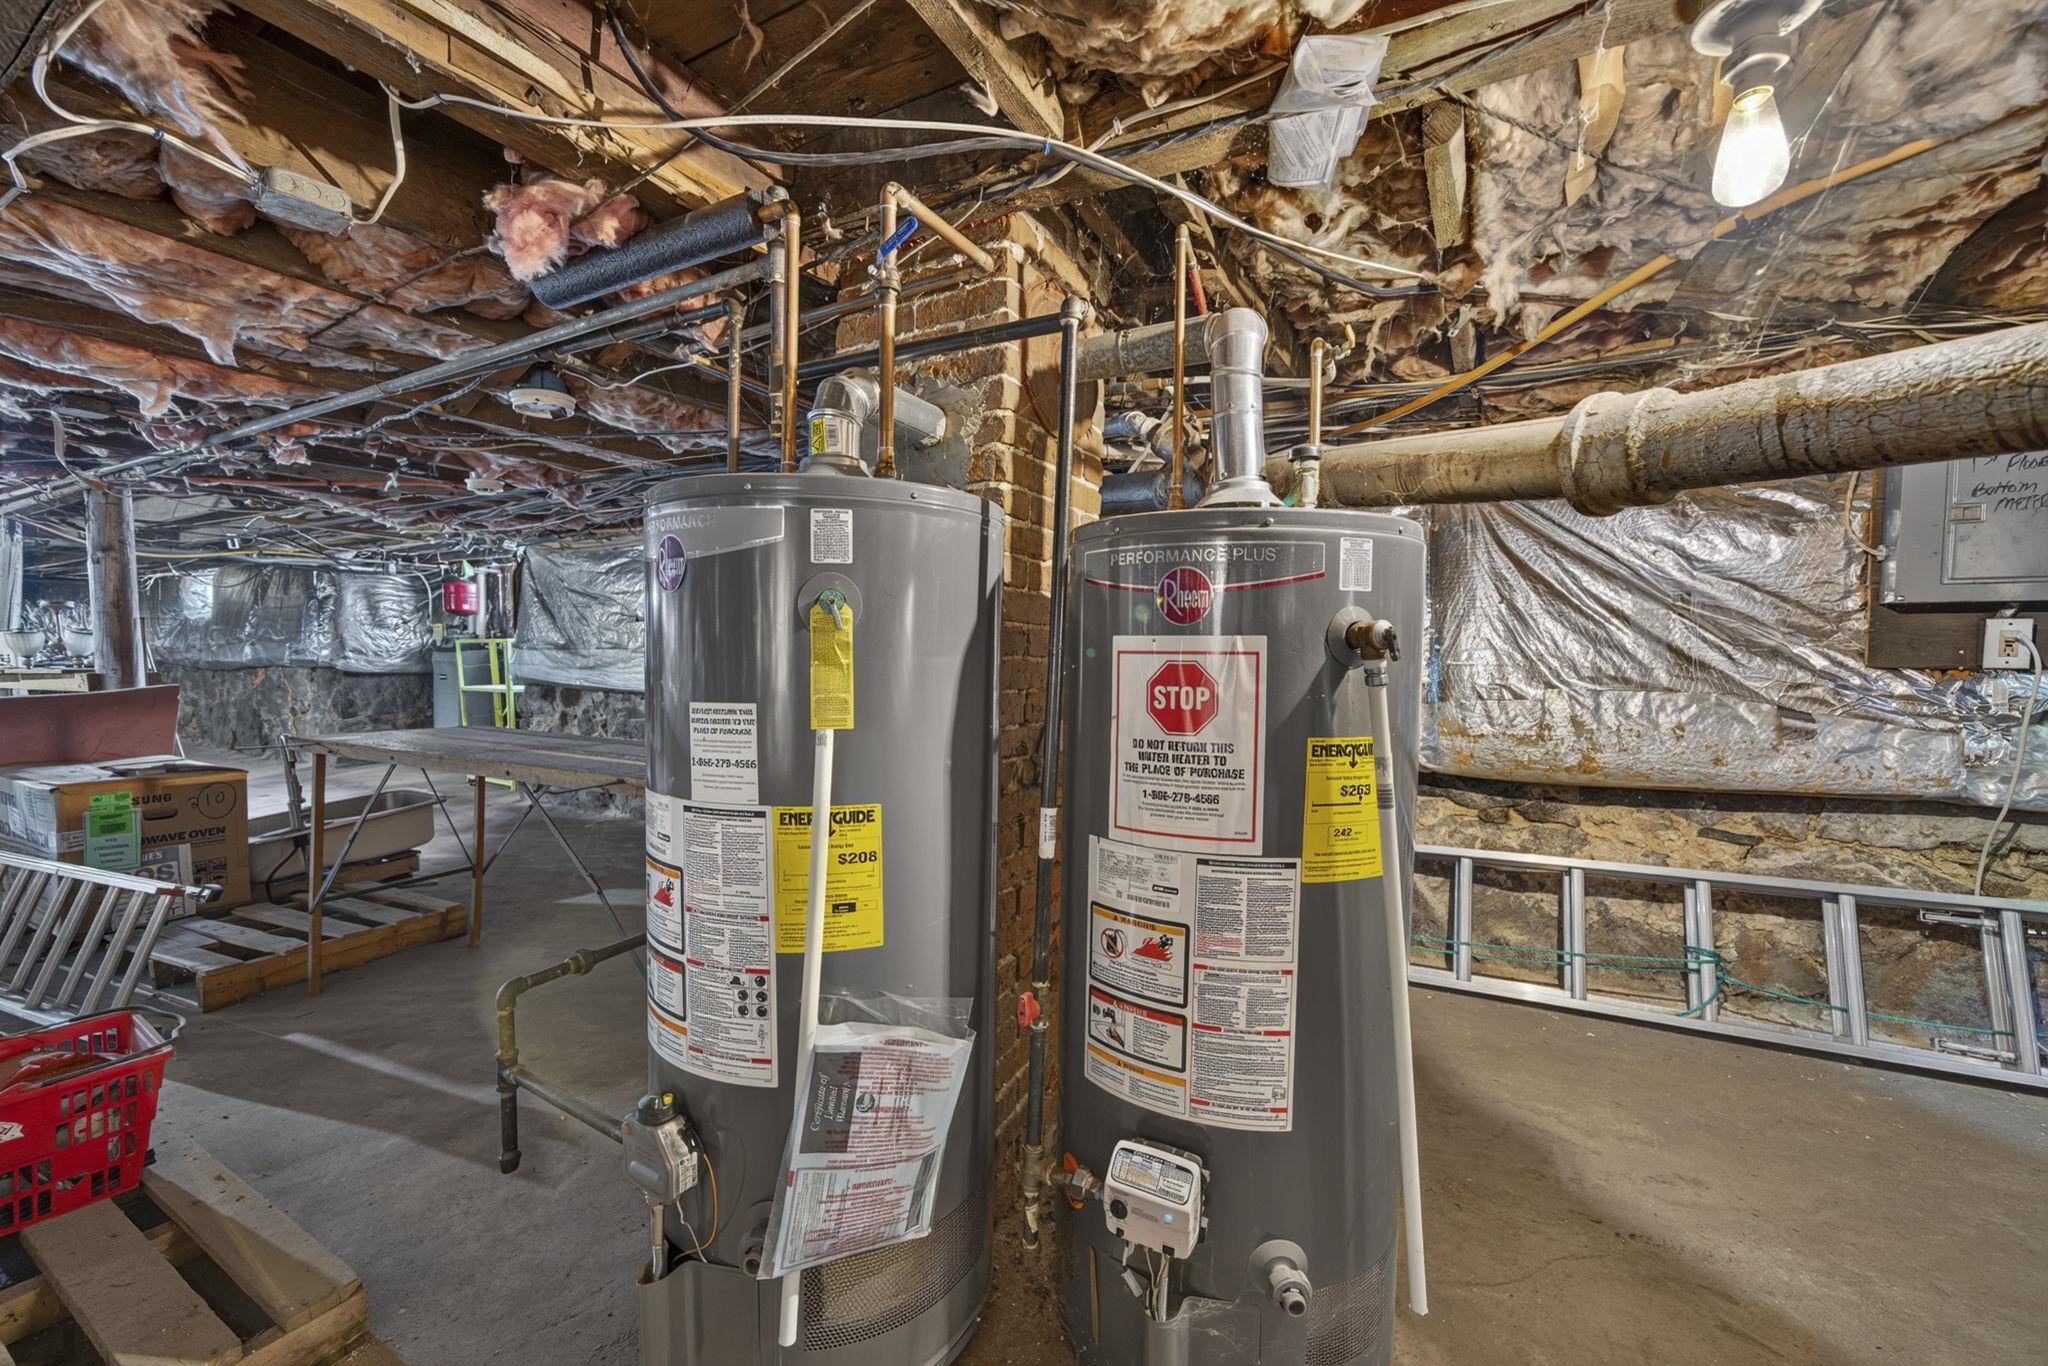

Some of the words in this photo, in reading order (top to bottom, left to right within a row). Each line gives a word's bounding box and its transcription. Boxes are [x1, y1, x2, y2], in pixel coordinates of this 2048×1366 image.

[1110, 548, 1227, 566] PERFORMANCE
[1233, 547, 1277, 562] PLUS
[1164, 569, 1209, 617] Rheem
[1153, 685, 1210, 711] STOP
[1133, 738, 1144, 749] DO
[1147, 739, 1165, 751] NOT
[1168, 741, 1207, 753] RETURN
[1211, 743, 1234, 754] THIS
[1138, 751, 1169, 763] WATER
[1172, 753, 1210, 766] HEATER
[1213, 755, 1227, 767] TO
[1124, 762, 1139, 772] THE
[1141, 763, 1171, 776] PLACE
[1174, 766, 1186, 776] OF
[1190, 767, 1245, 780] PURCHASE
[131, 793, 172, 806] SUNG
[189, 826, 226, 839] OVEN
